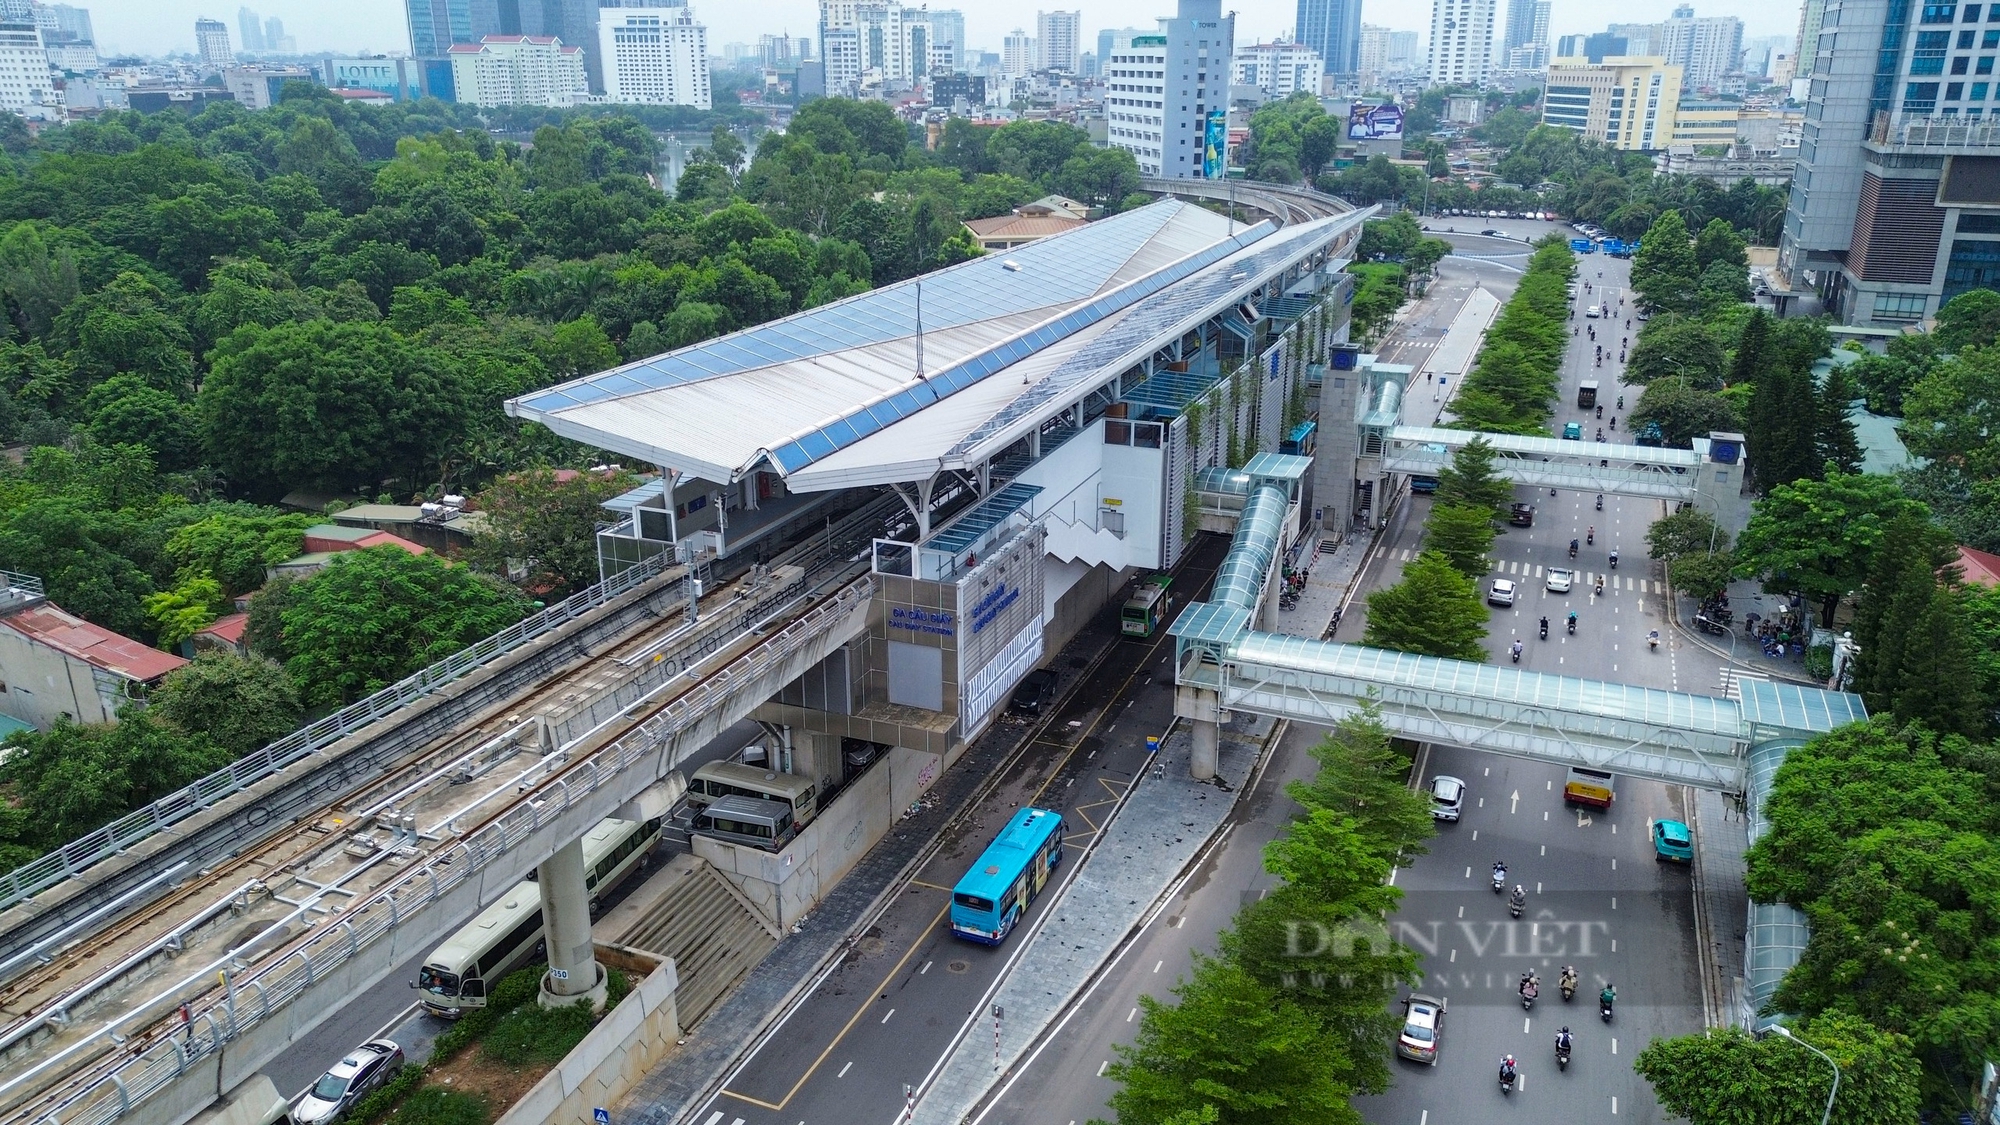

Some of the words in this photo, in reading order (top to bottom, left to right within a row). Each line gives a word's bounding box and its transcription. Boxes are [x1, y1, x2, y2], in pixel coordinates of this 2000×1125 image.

[340, 65, 391, 79] LOTTE
[893, 607, 906, 618] GA
[922, 625, 954, 636] STATION
